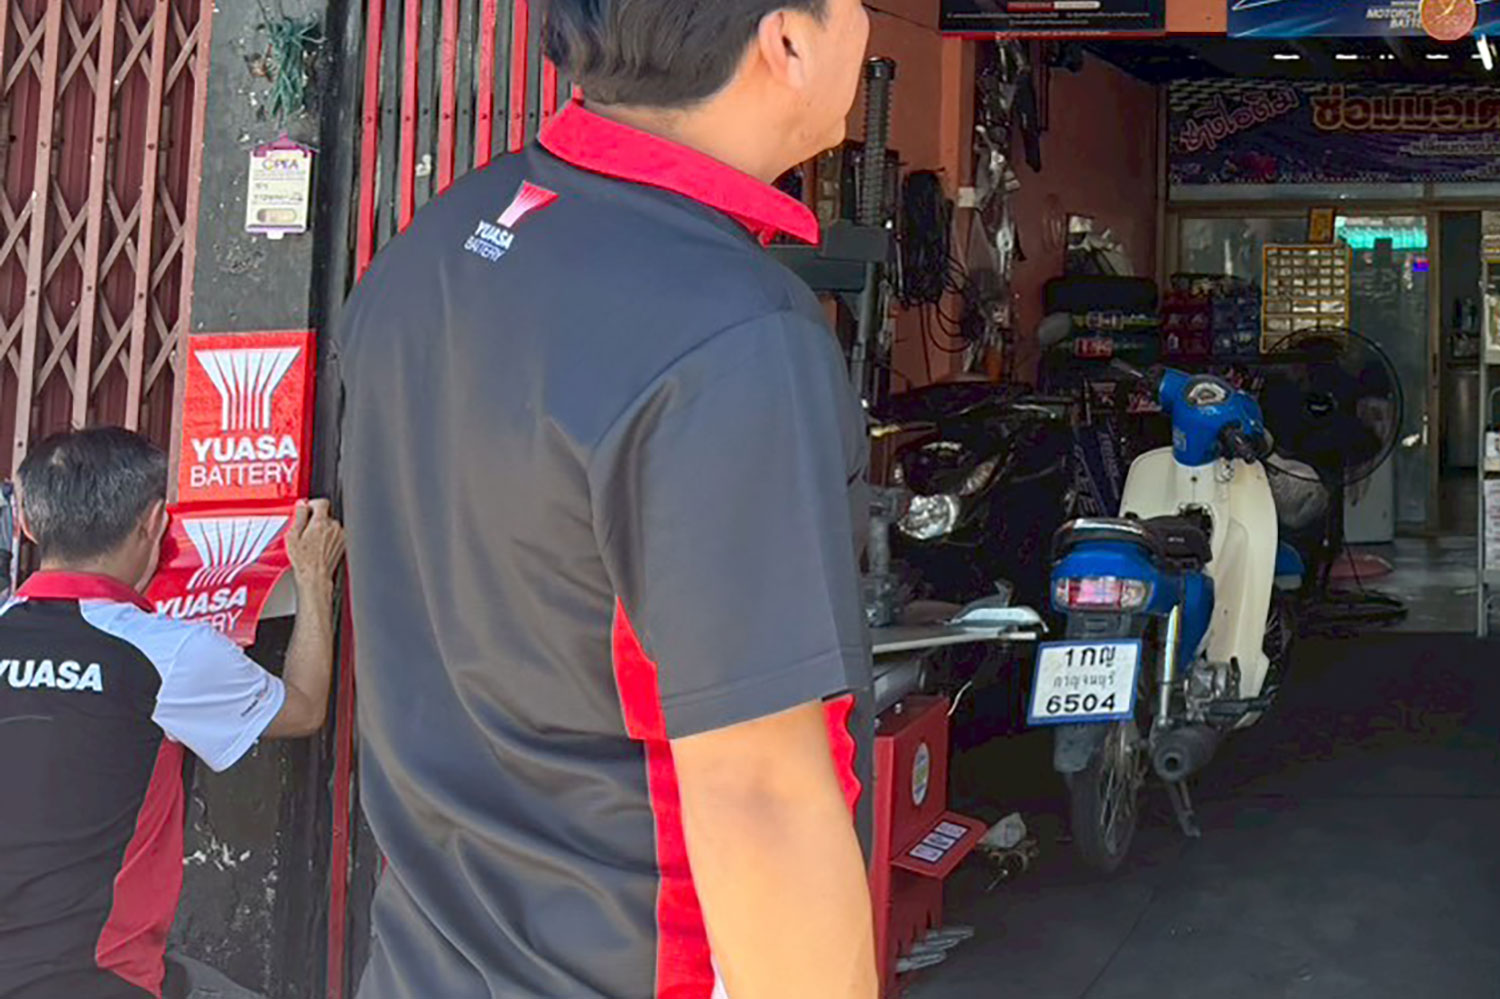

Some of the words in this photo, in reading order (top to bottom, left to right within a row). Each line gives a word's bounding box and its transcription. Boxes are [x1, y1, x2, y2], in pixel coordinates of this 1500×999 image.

[464, 235, 506, 262] BATTERY
[474, 219, 515, 250] YUASA
[190, 434, 299, 464] YUASA
[190, 460, 299, 488] BATTERY
[156, 585, 247, 620] YUASA
[1053, 671, 1115, 689] กาญจนบุรี
[1046, 693, 1116, 714] 6504
